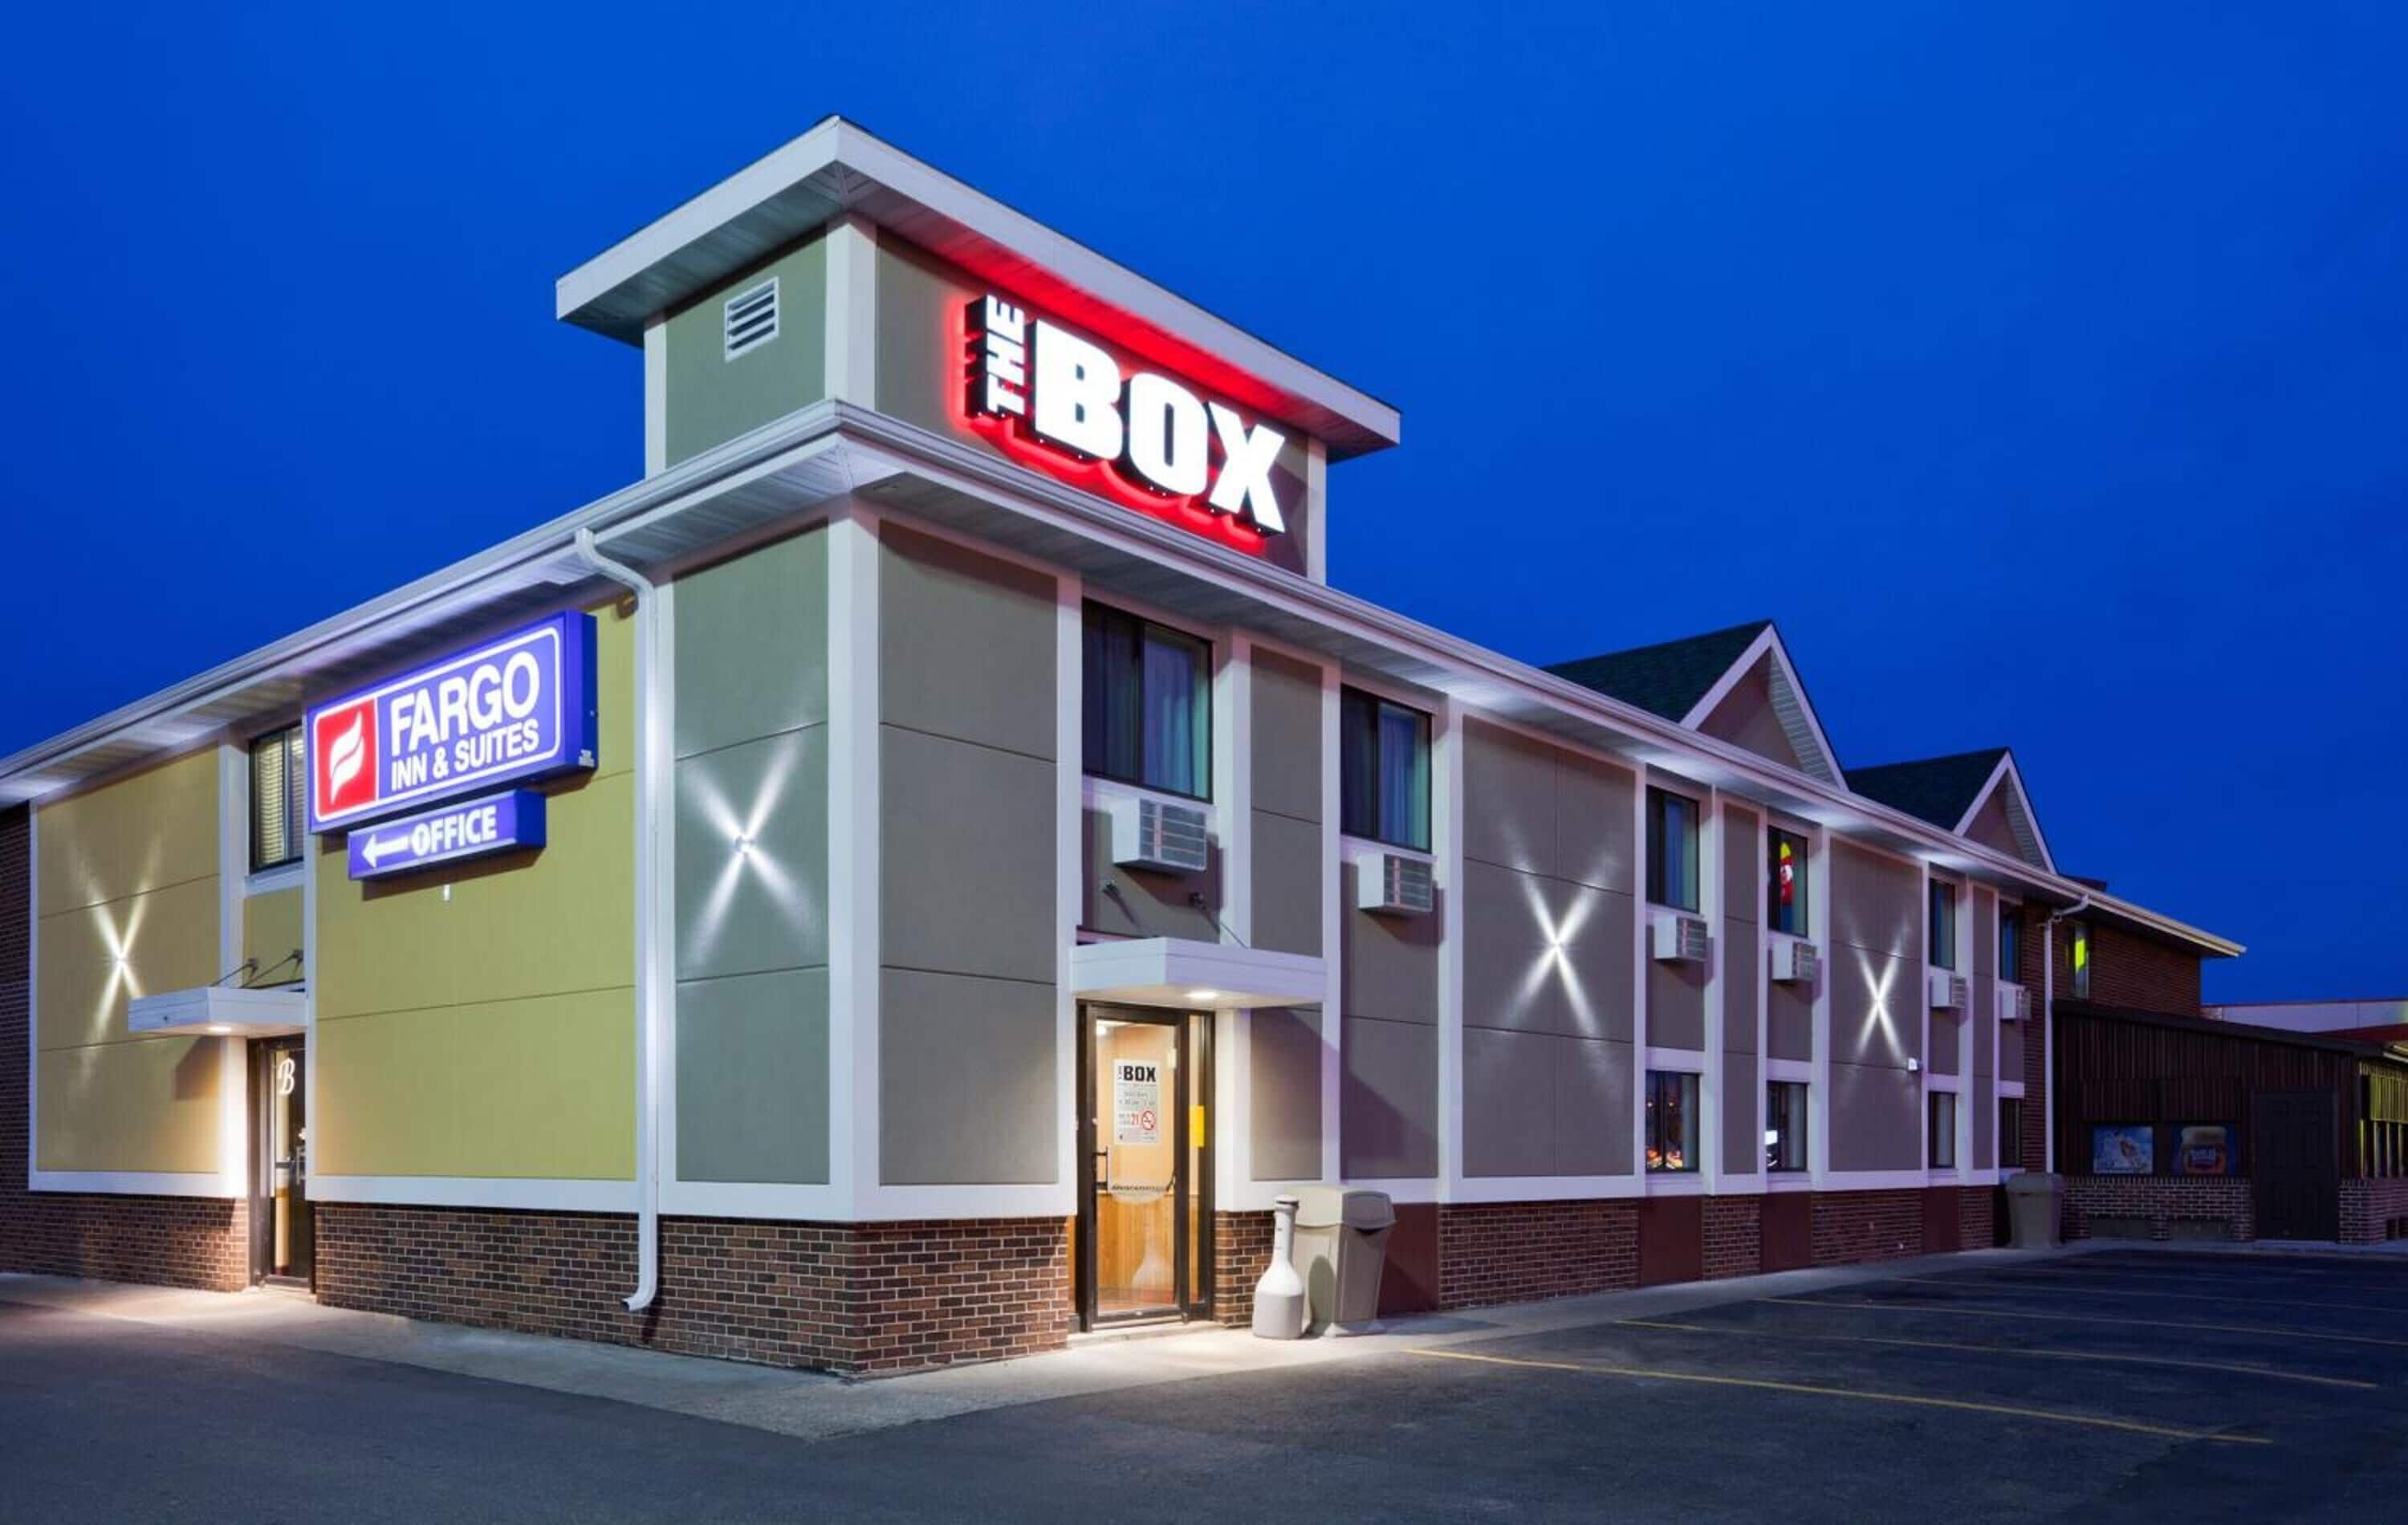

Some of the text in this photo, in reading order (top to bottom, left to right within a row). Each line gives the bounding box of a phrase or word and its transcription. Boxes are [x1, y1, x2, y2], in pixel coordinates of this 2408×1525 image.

[986, 295, 1025, 416] THE
[1035, 319, 1285, 533] BOX
[390, 651, 540, 758] FARGO
[391, 718, 540, 792] INN & SUITES
[411, 805, 498, 856] OFFICE
[1124, 1065, 1157, 1083] BOX
